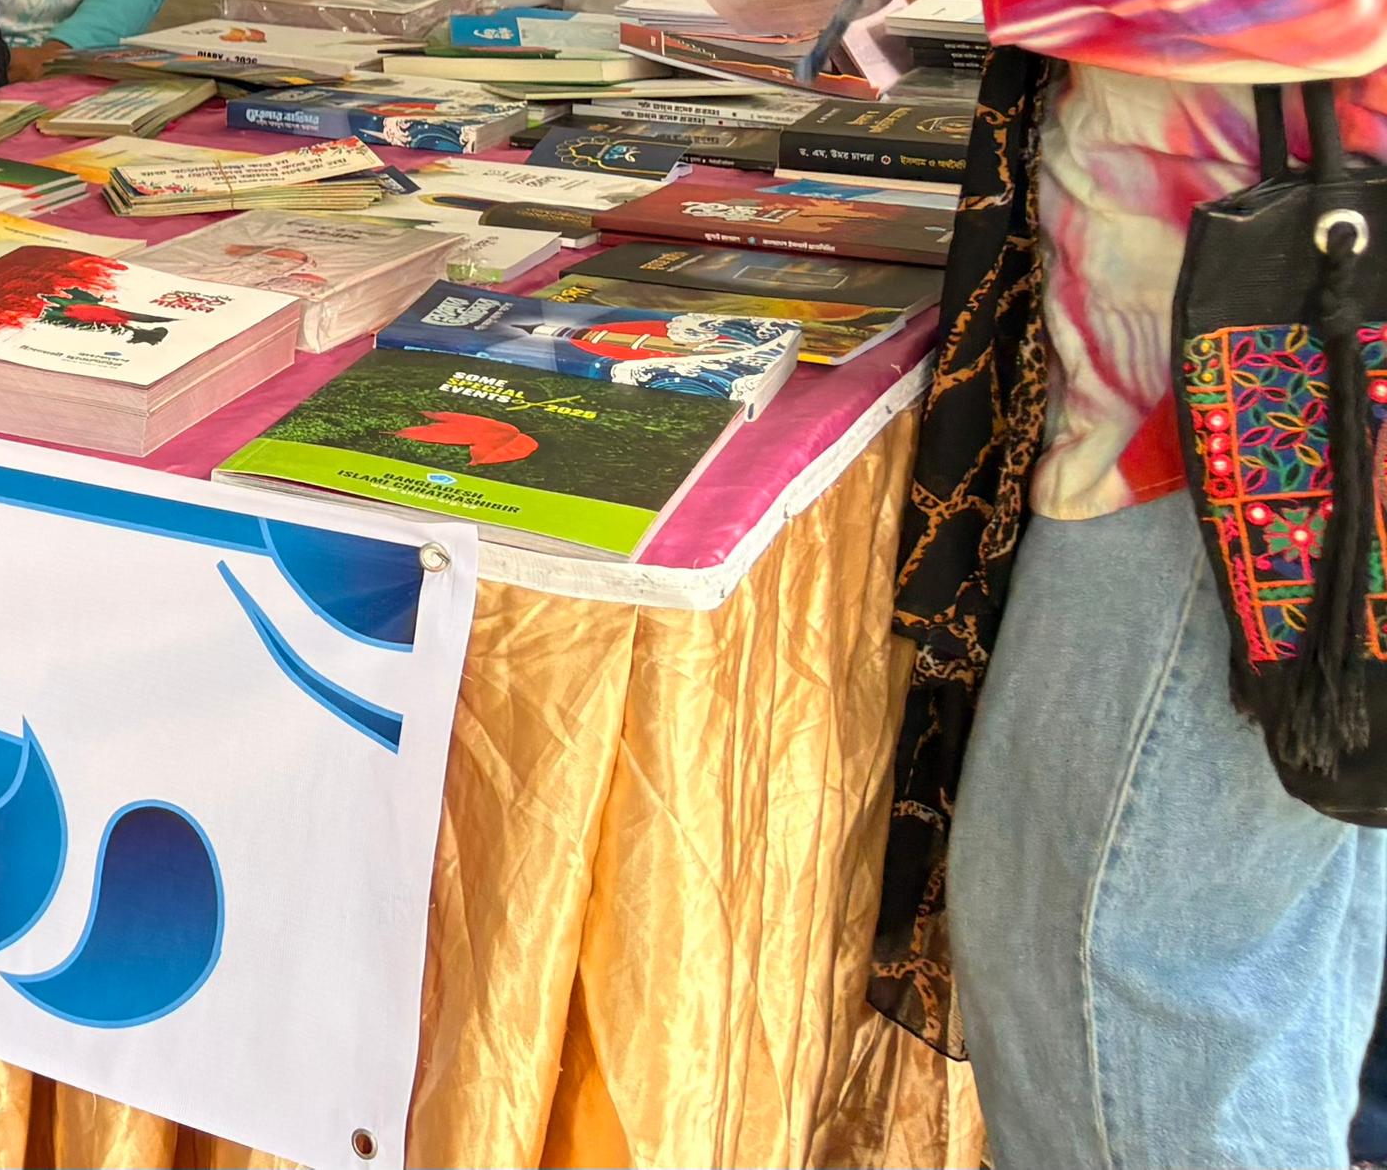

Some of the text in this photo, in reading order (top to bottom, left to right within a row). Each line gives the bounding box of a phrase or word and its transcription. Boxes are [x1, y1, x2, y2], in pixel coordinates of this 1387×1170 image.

[446, 377, 525, 399] SPECIAL
[453, 371, 509, 388] SOME
[438, 383, 512, 404] EVENTS
[336, 469, 522, 514] ISLAMI CHHATRASHIBIR
[383, 472, 485, 499] BANGLADESH
